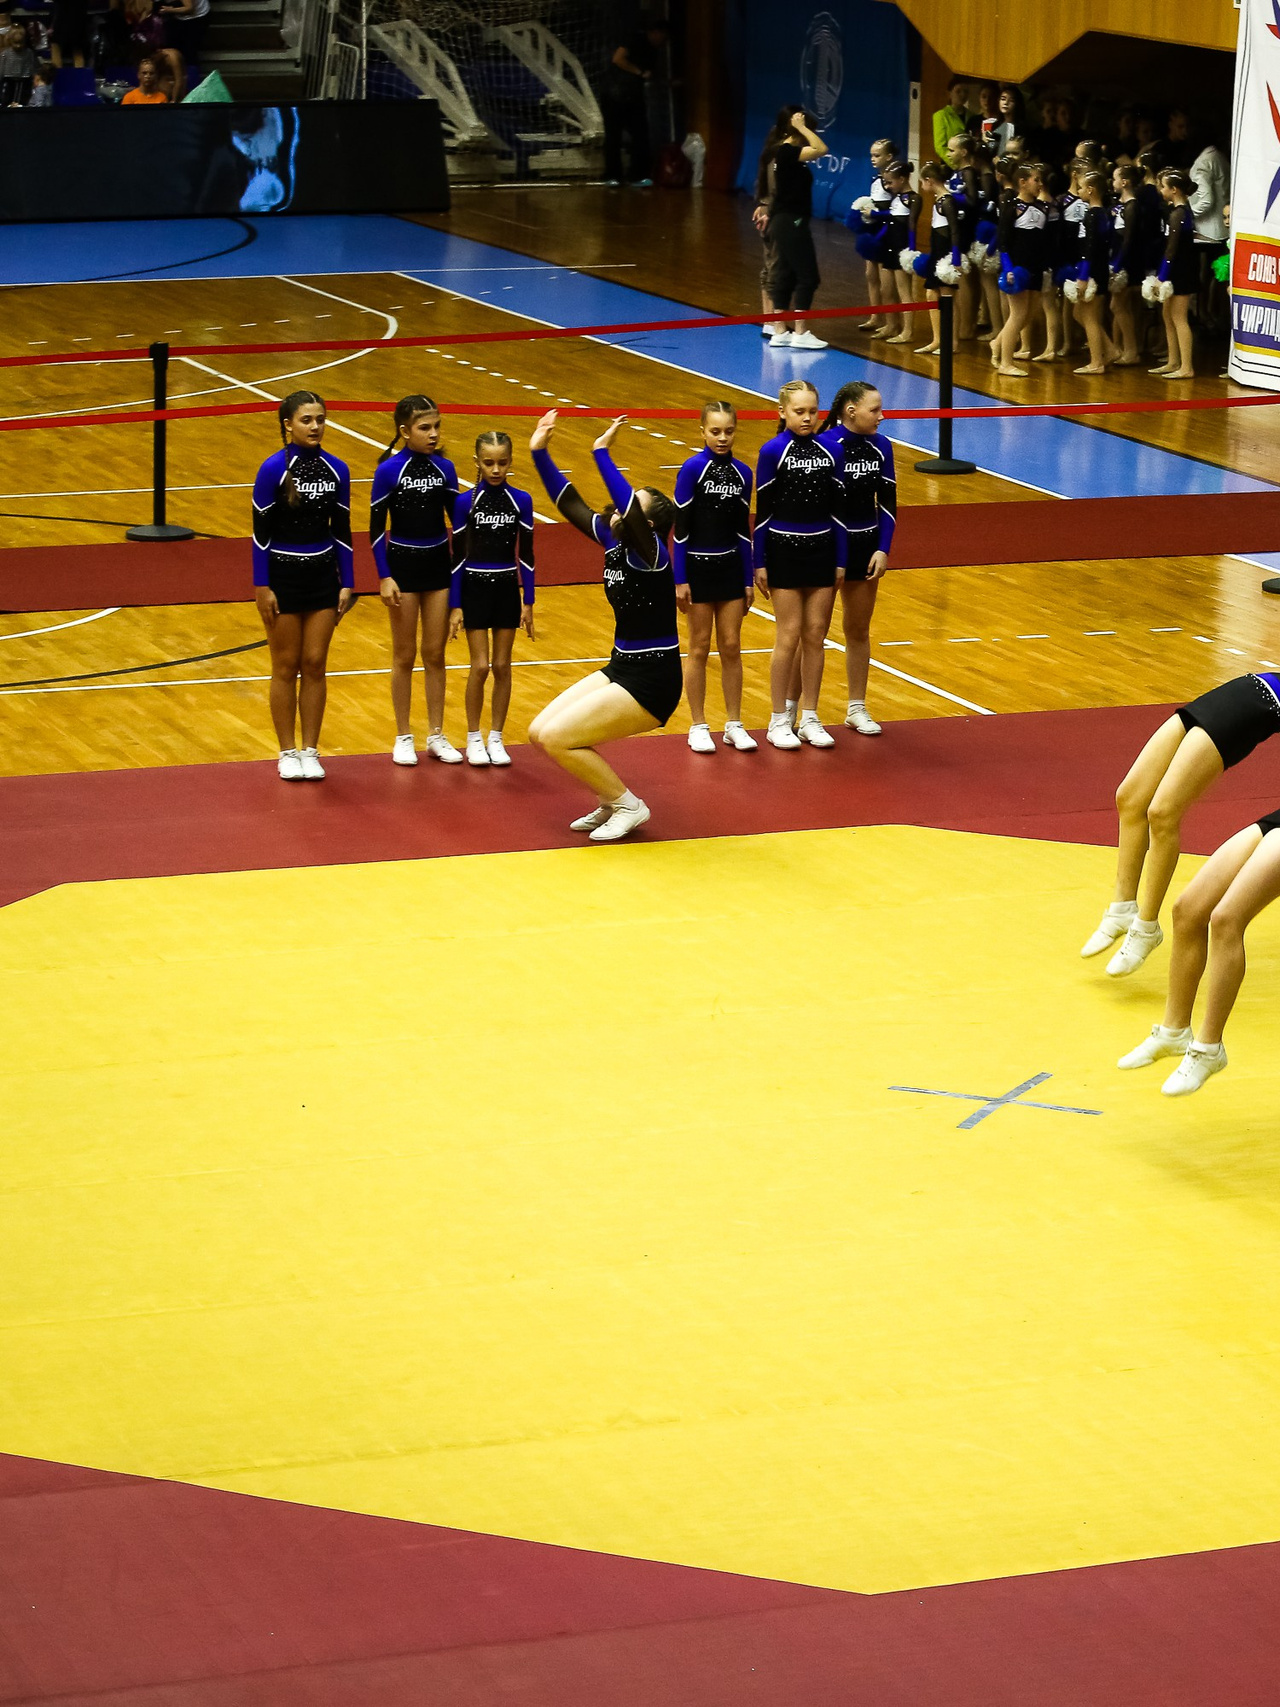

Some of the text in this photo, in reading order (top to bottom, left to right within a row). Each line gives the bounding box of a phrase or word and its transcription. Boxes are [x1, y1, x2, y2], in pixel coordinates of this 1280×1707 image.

[785, 456, 830, 474] Bagira
[844, 459, 880, 480] agira
[401, 476, 443, 494] Bagira
[474, 512, 516, 530] Bagira
